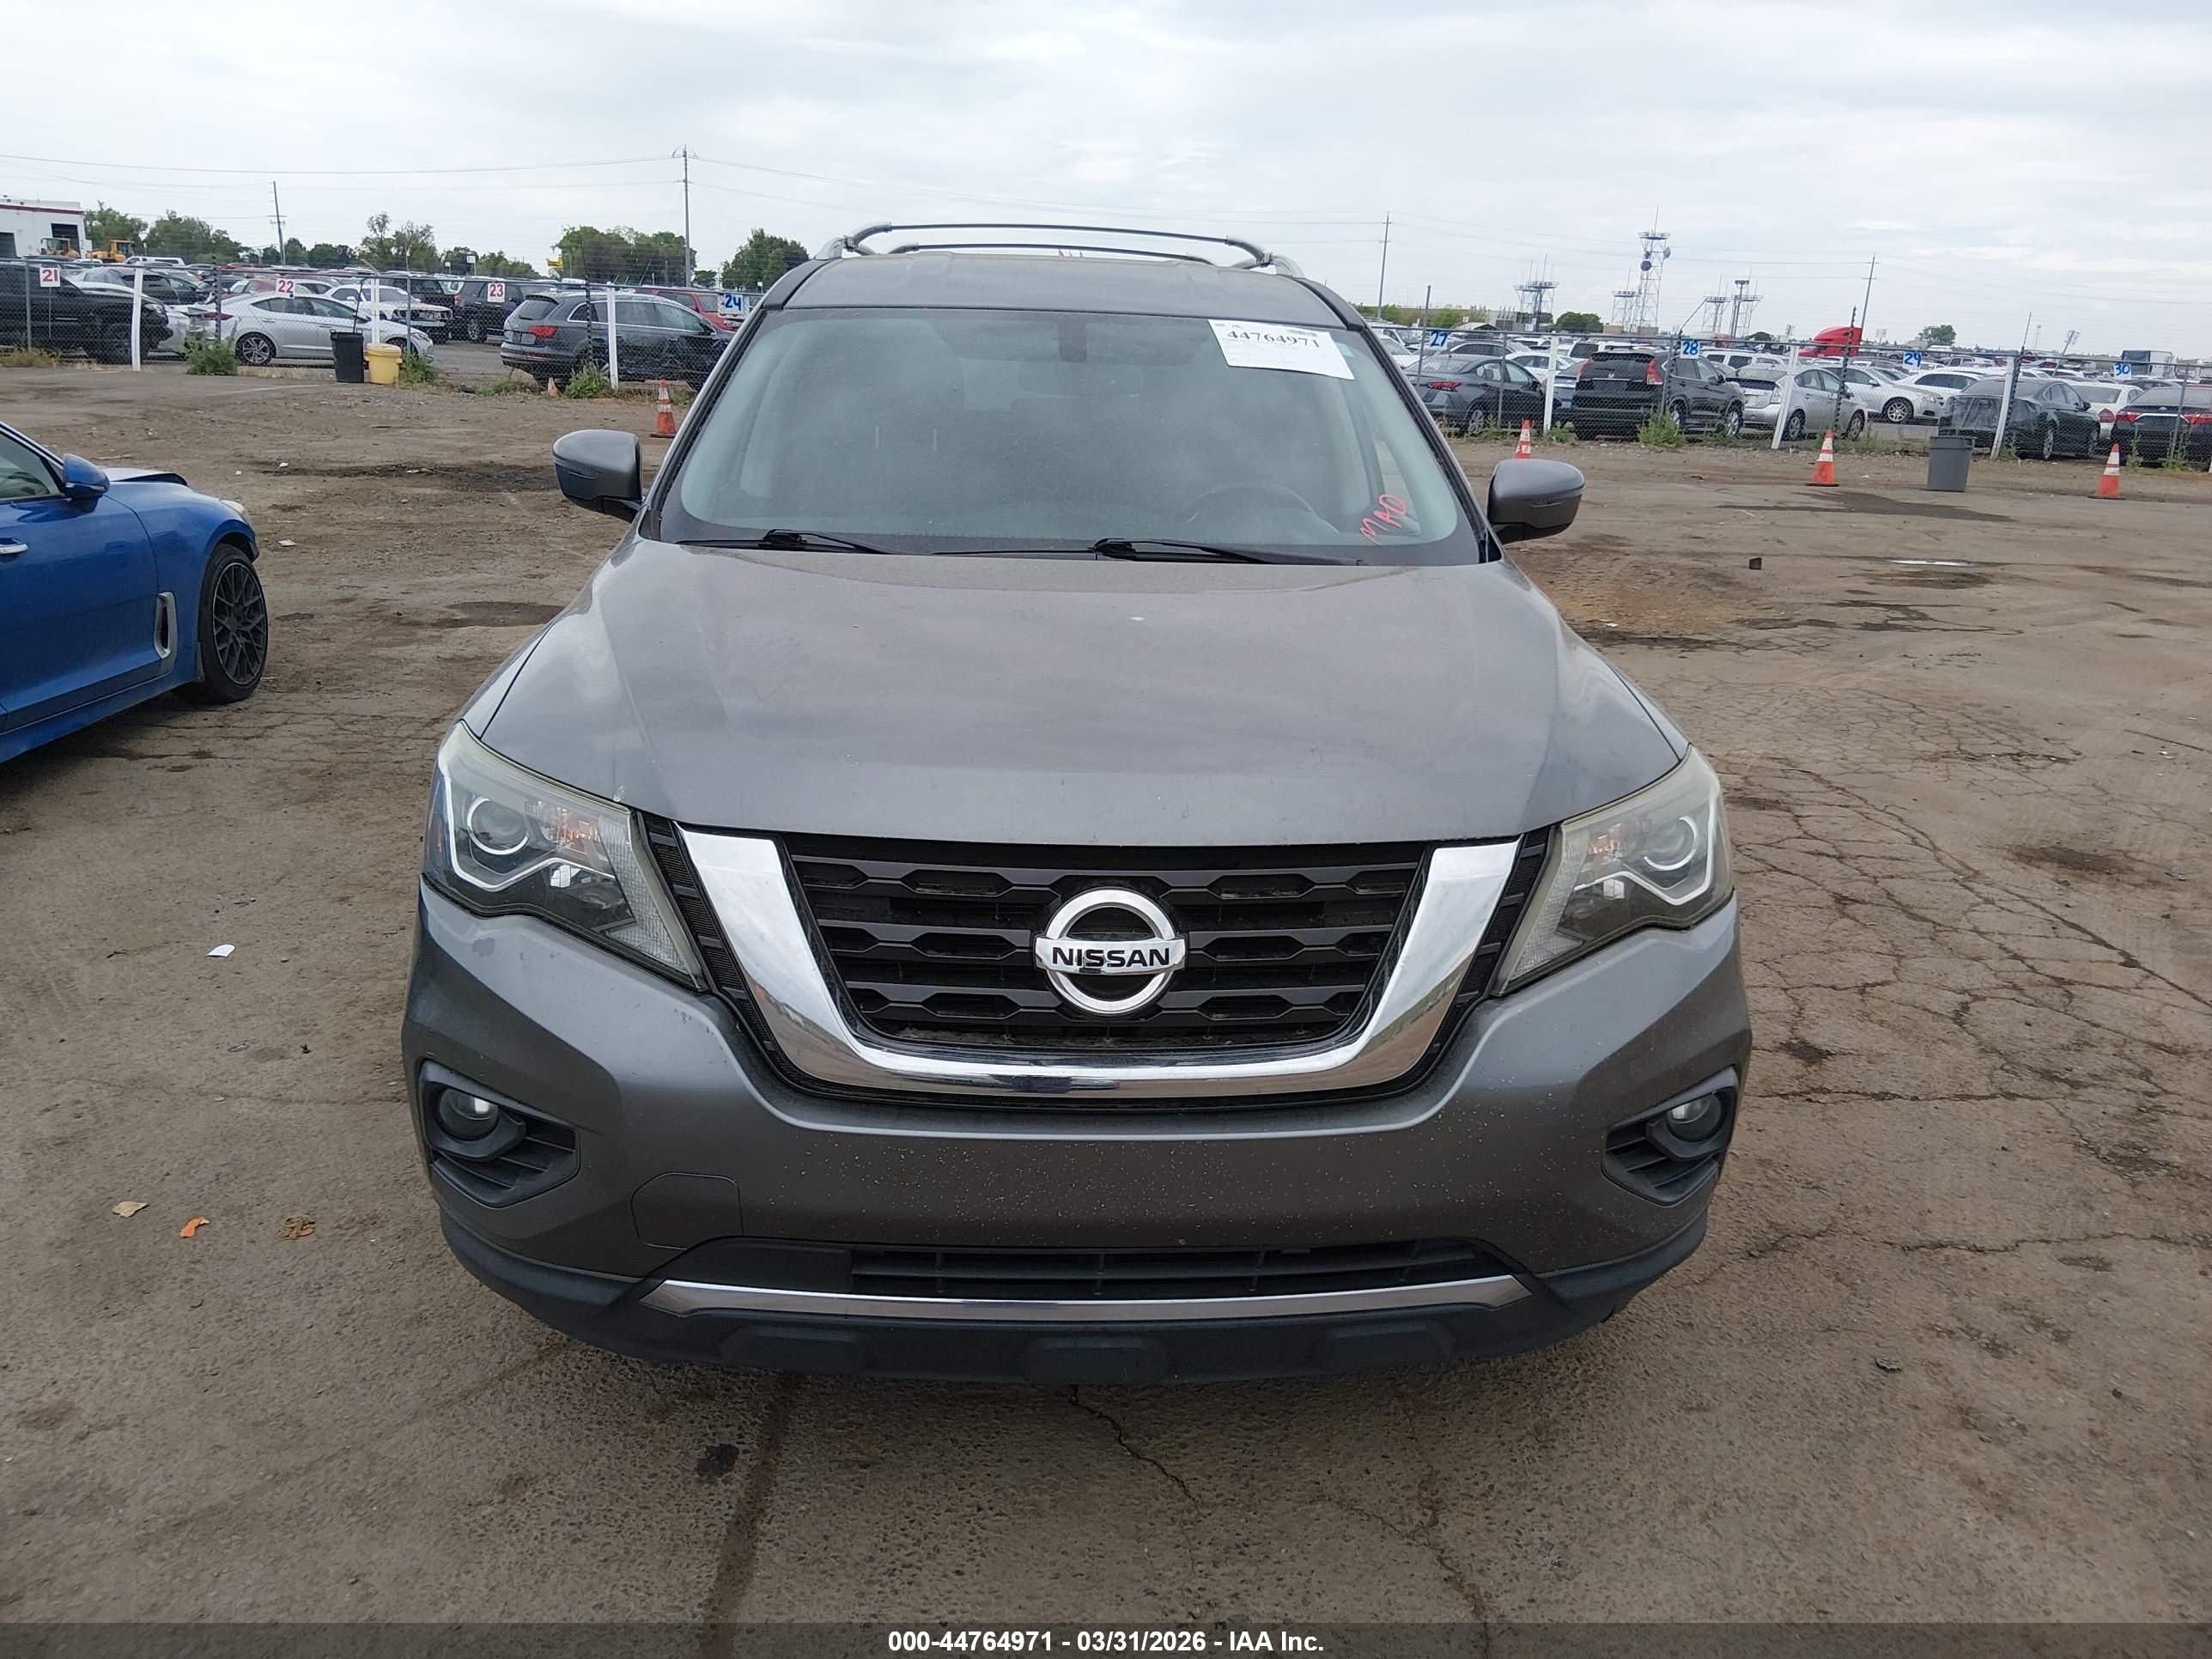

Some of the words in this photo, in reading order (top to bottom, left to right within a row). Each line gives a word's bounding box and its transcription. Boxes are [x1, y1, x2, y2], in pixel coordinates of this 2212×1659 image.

[42, 270, 58, 282] 21
[278, 280, 294, 293] 22
[489, 283, 503, 297] 23
[725, 295, 741, 311] 24
[1227, 331, 1320, 348] 44764971
[1431, 331, 1449, 347] 27
[1682, 340, 1698, 356] 28
[1904, 352, 1922, 368] 29
[2115, 362, 2130, 376] 30
[1052, 946, 1170, 968] NISSAN
